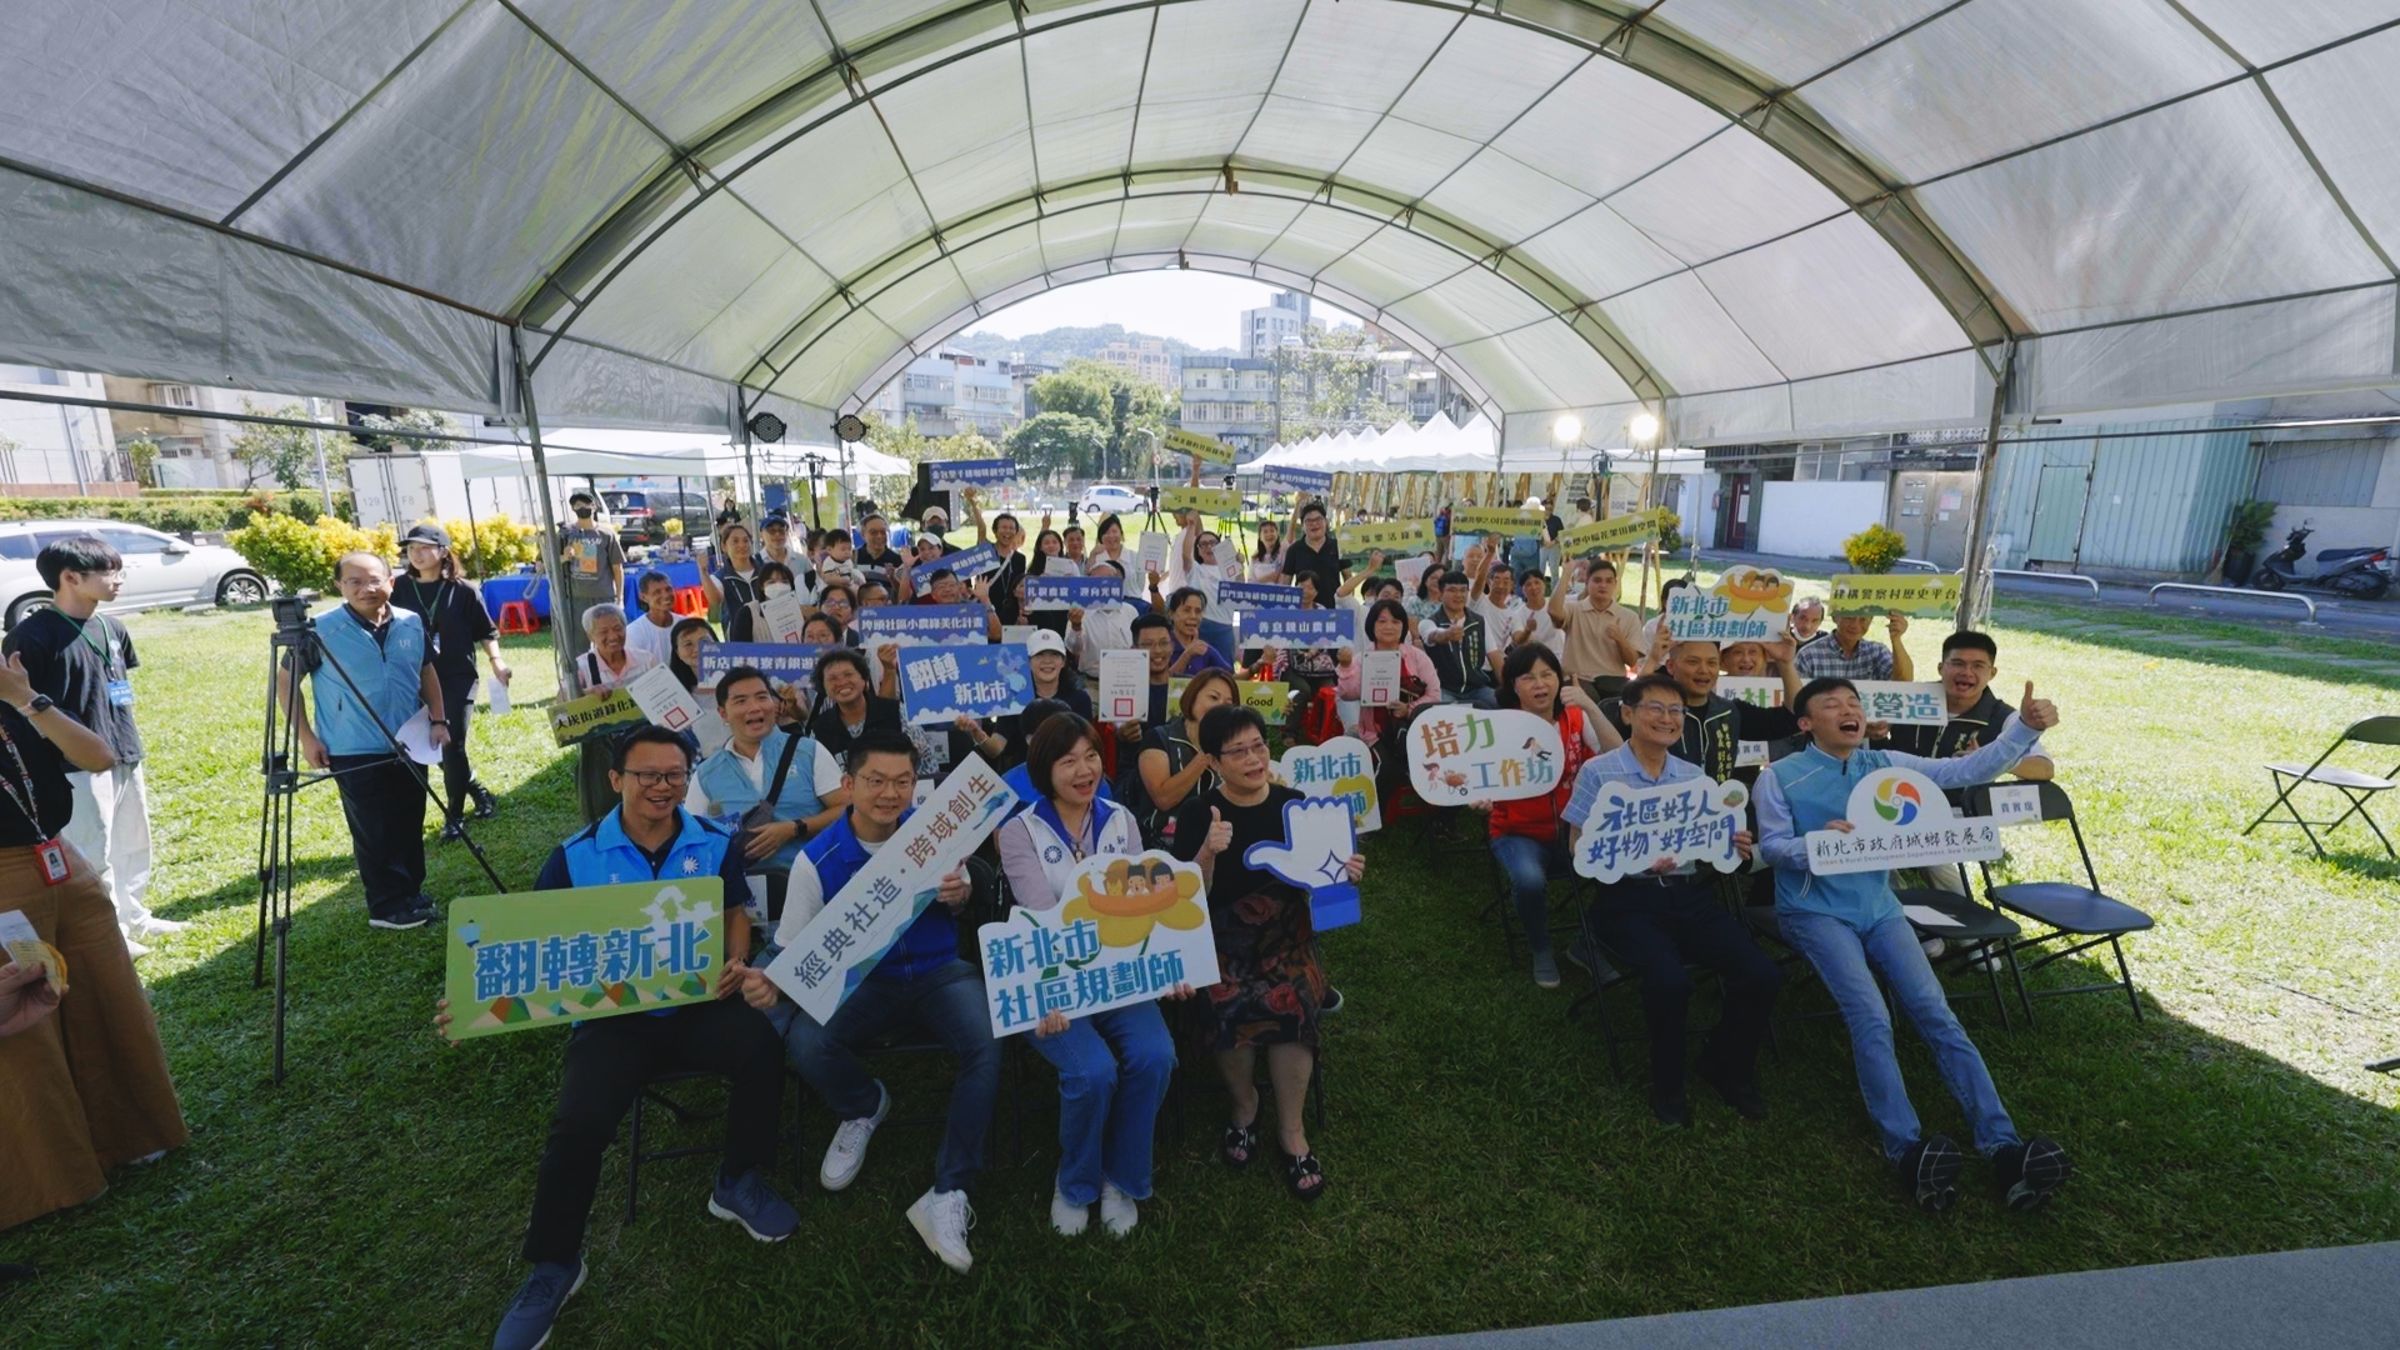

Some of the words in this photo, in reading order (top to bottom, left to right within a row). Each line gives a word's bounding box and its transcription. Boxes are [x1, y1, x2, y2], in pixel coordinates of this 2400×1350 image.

[1670, 595, 1729, 615] 新北市
[1669, 620, 1768, 638] 社區規劃師
[905, 652, 960, 692] 翻轉
[954, 680, 1008, 705] 新北市
[1246, 696, 1273, 707] Good
[1420, 713, 1495, 759] 培力
[1738, 743, 1761, 754] 賓席
[1293, 752, 1361, 783] 新北市
[1471, 757, 1554, 790] 工作坊
[1596, 789, 1720, 832] 社區好人
[2001, 801, 2033, 813] 貴賓席
[1817, 825, 1994, 857] 新北市政府城鄉發展局
[473, 919, 711, 1002] 翻轉新北
[986, 918, 1102, 979] 新北市
[993, 949, 1186, 1028] 社區規劃師
